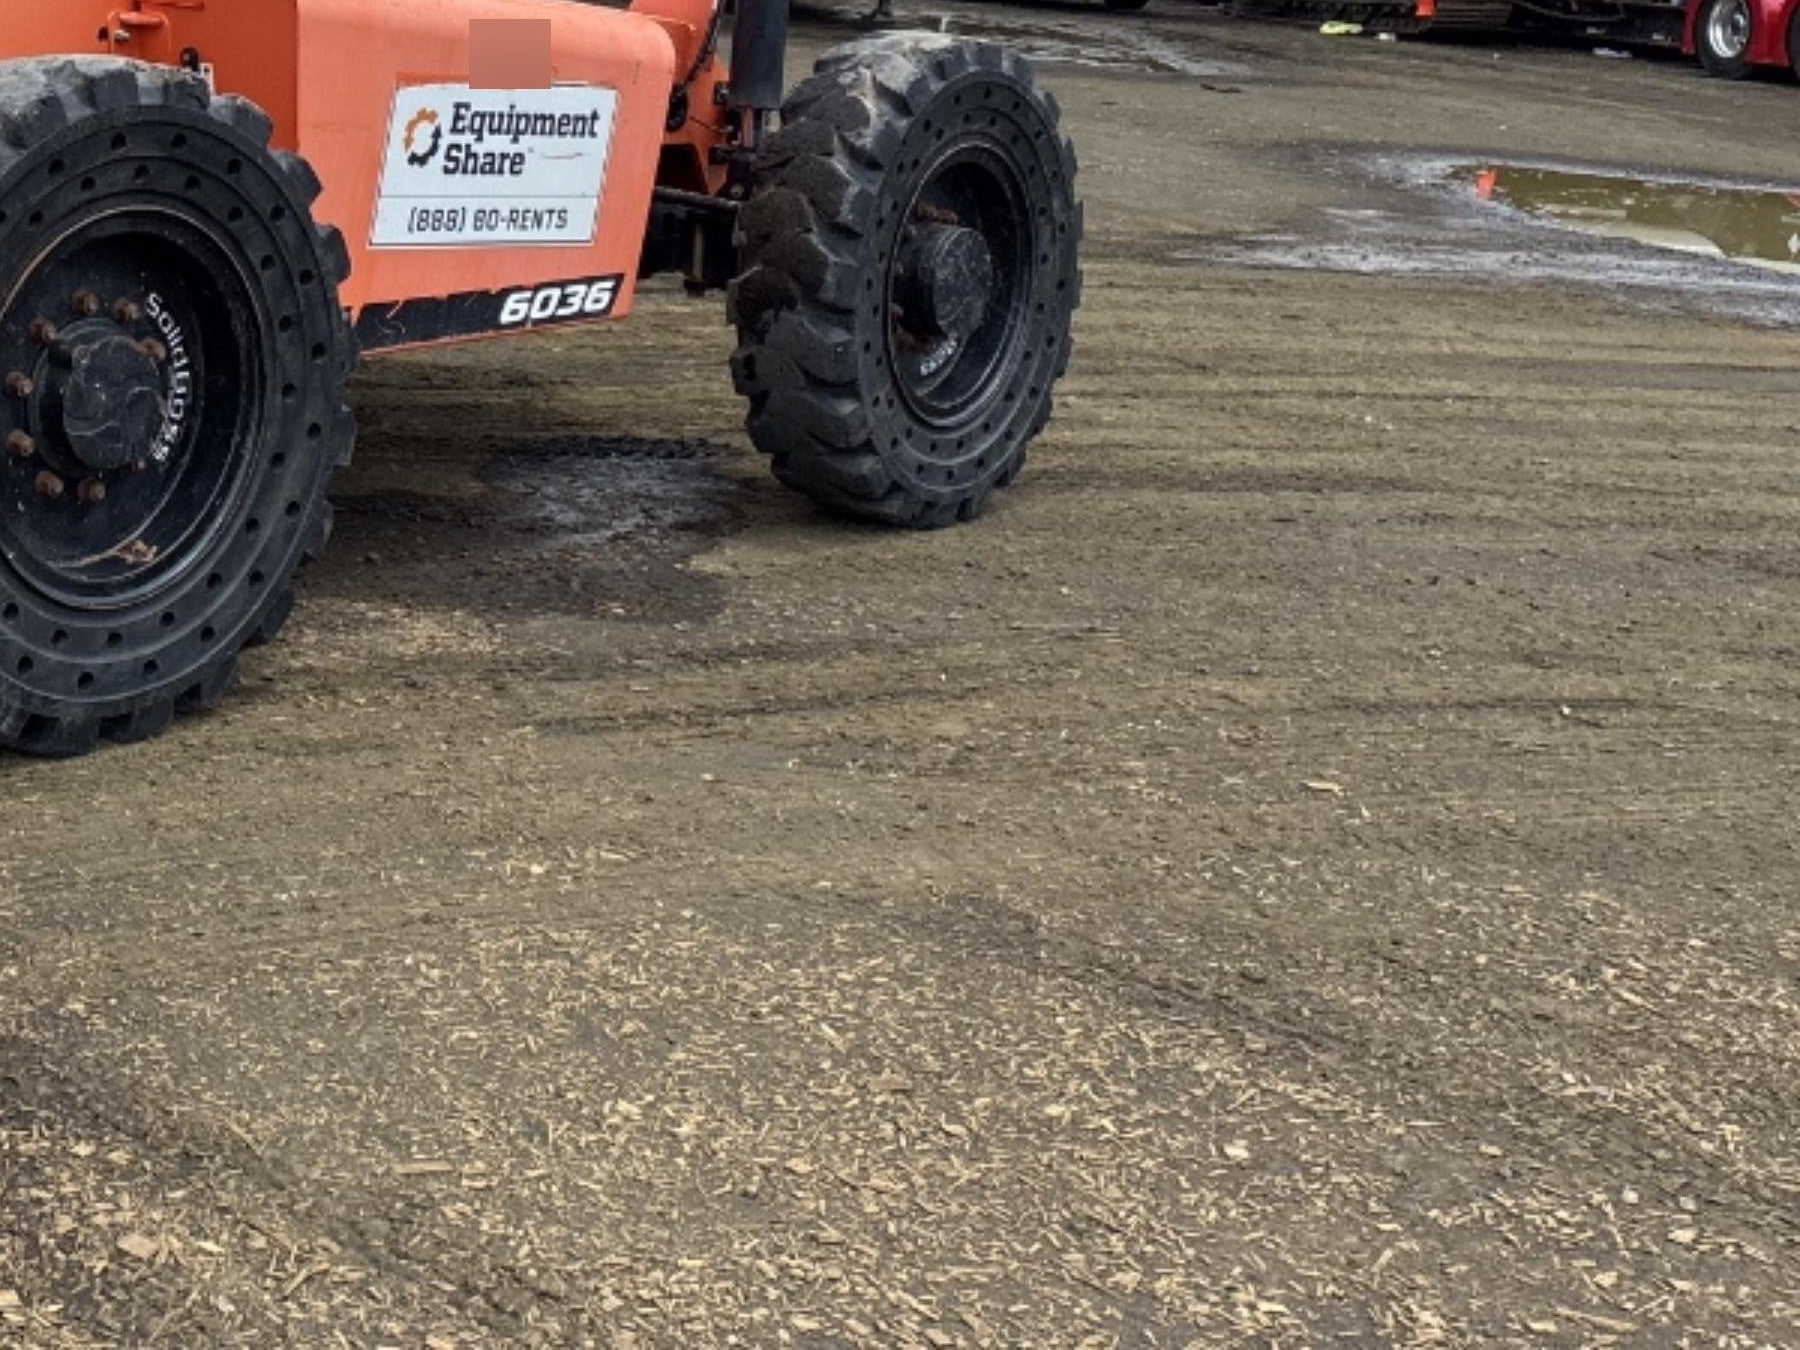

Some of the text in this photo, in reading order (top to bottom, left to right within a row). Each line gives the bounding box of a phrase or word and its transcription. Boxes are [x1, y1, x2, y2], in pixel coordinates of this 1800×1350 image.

[449, 101, 601, 144] Equipment
[442, 142, 526, 176] Share
[406, 206, 569, 234] (888) 80-RENTS
[499, 277, 618, 326] 6036
